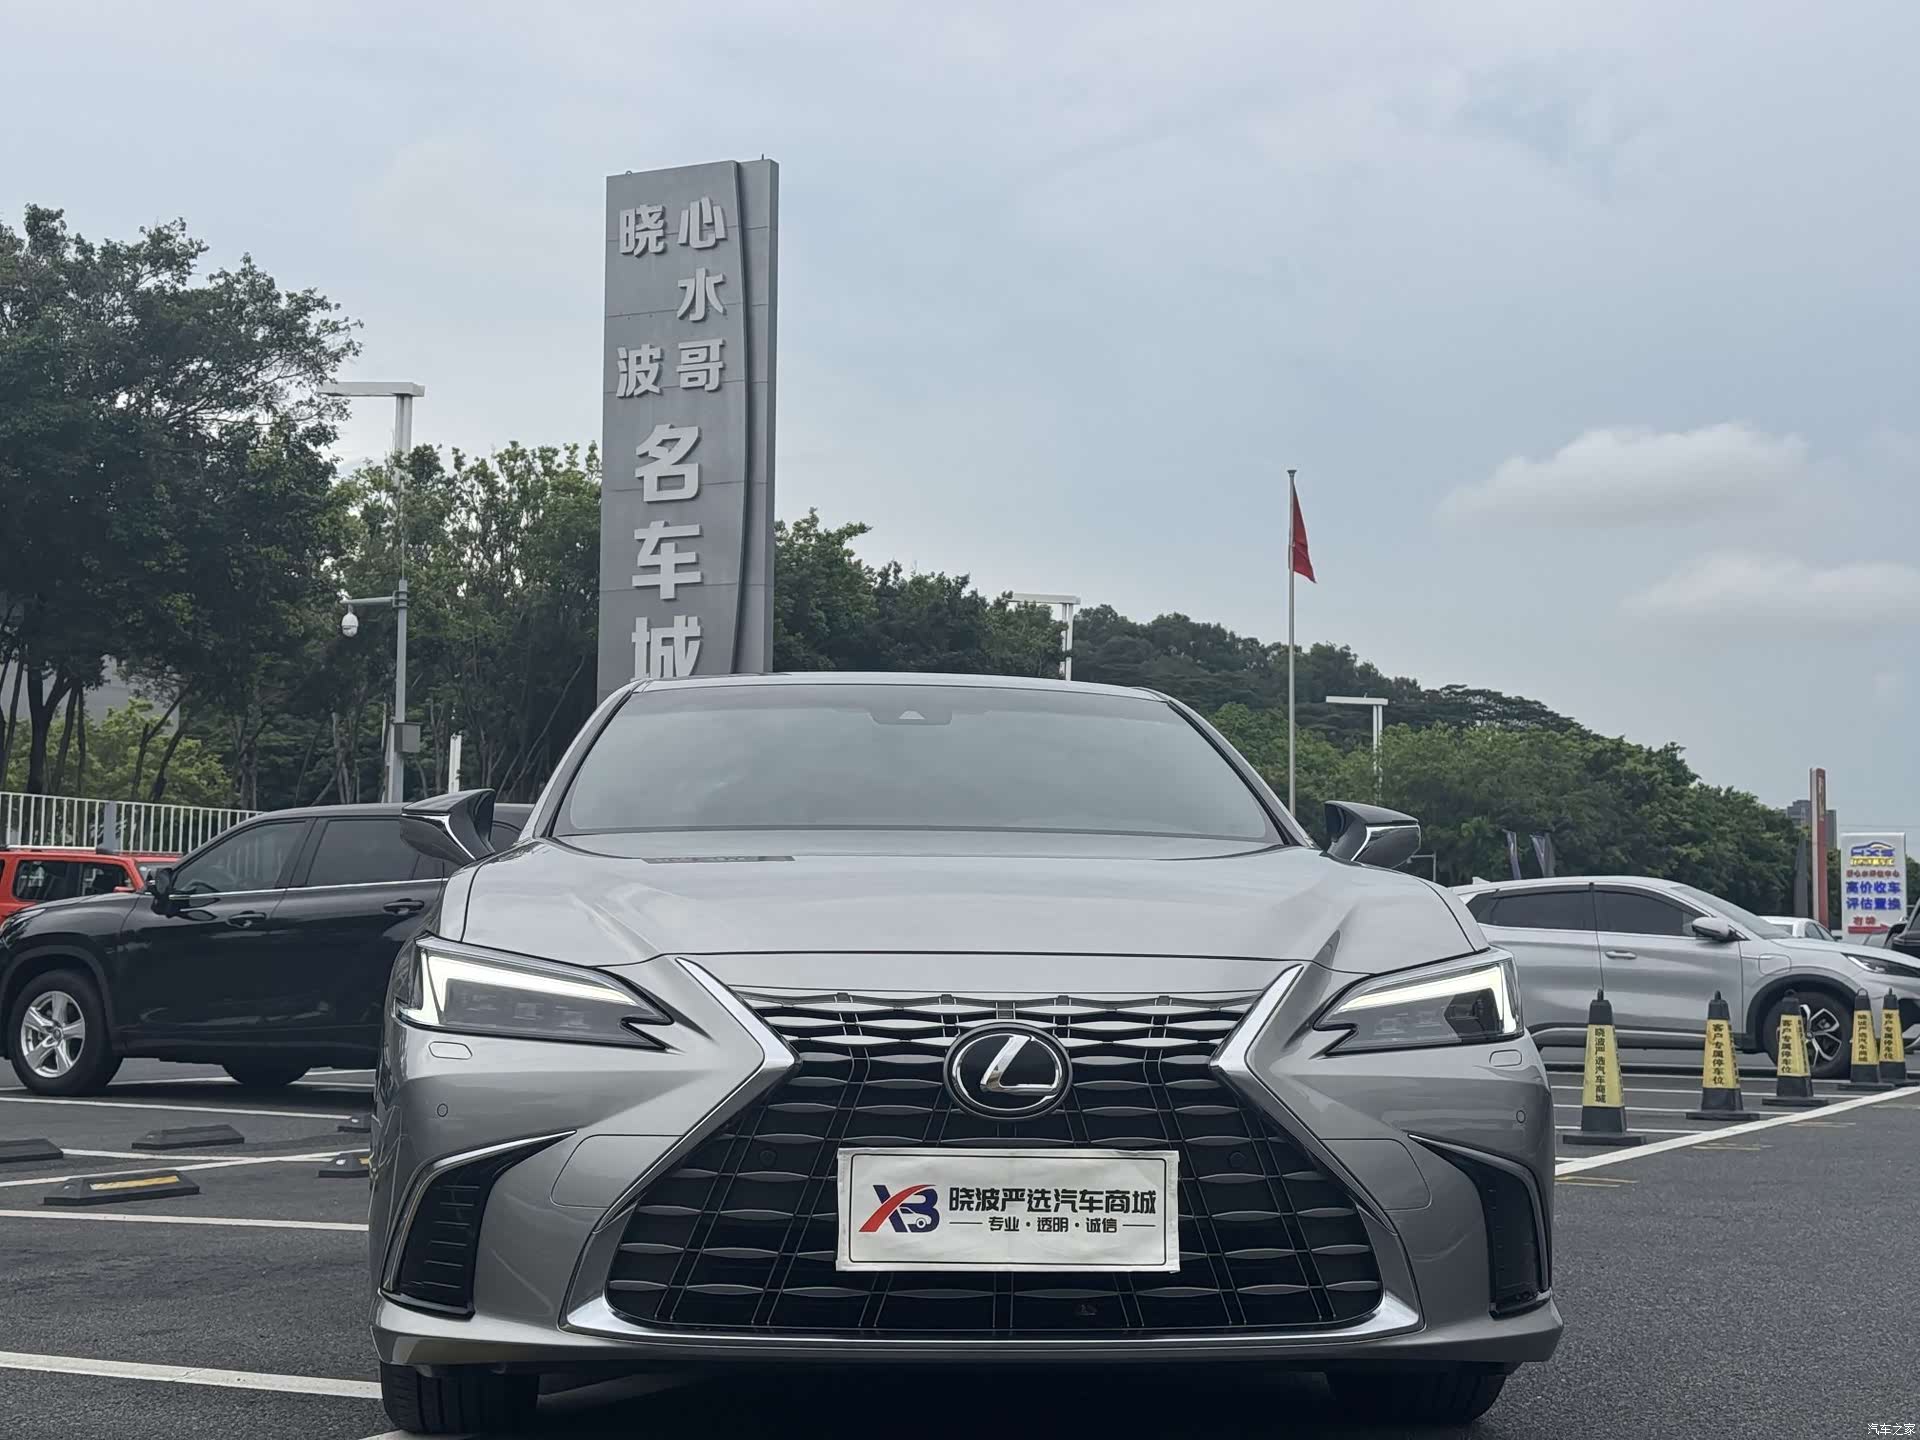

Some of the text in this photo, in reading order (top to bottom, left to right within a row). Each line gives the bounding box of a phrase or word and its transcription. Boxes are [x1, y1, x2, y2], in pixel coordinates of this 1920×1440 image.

[1846, 881, 1901, 895] 高价收车
[1846, 897, 1901, 911] 评估置换
[1712, 1023, 1725, 1085] 客户专属停车位
[1781, 1019, 1792, 1074] 客户专属停车位
[949, 1187, 1156, 1214] 晓波严选汽车商城
